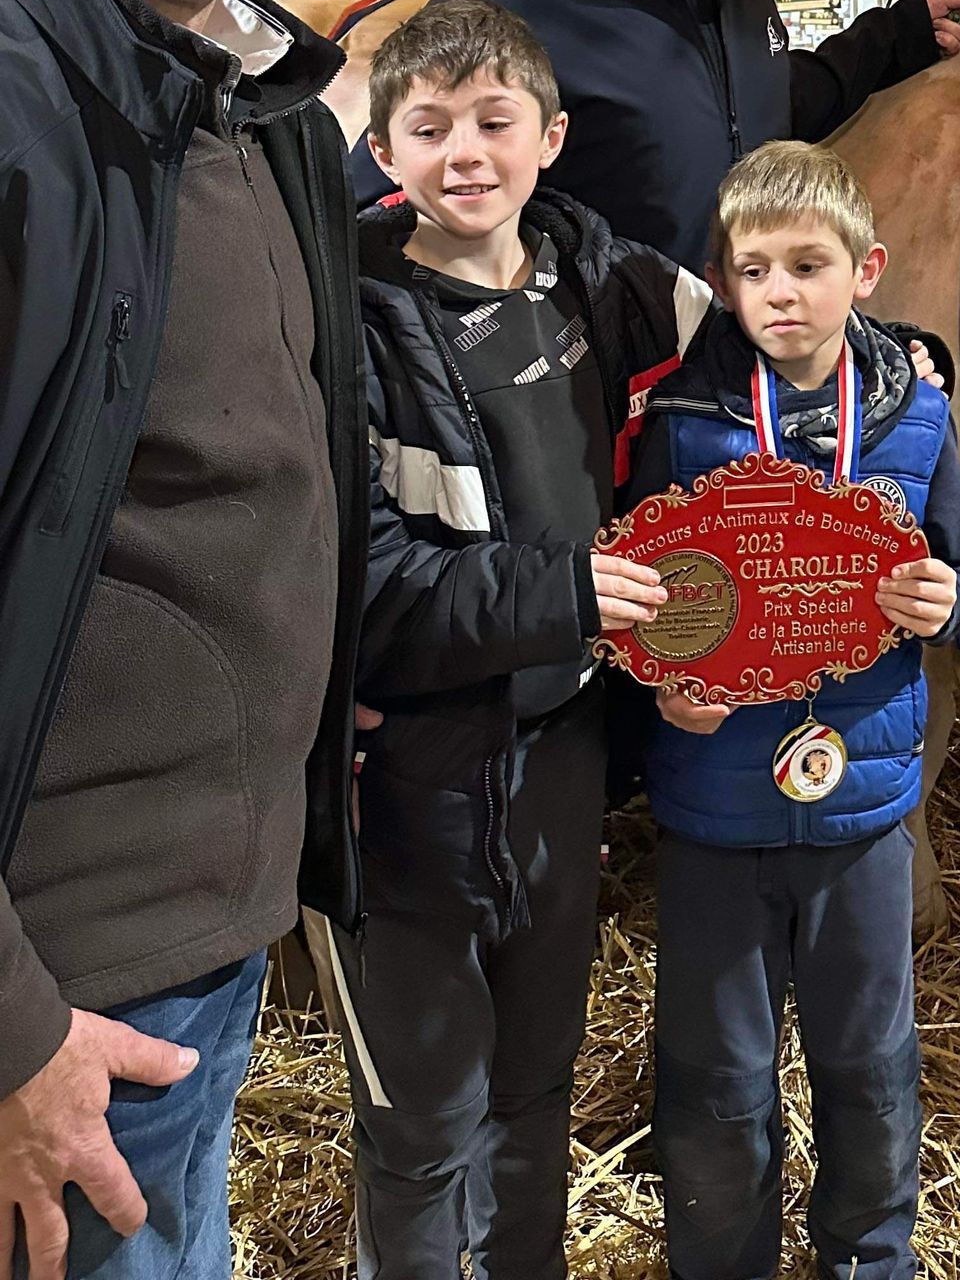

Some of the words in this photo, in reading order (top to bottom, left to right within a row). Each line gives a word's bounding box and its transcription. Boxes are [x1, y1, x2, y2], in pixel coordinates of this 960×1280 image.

[698, 512, 789, 534] d'Animaux
[794, 509, 815, 528] de
[820, 512, 900, 554] Boucherie
[735, 532, 785, 556] 2023
[739, 554, 879, 580] CHAROLLES
[668, 580, 726, 602] FBCT
[764, 600, 793, 617] Prix
[798, 596, 853, 616] Spécial
[749, 624, 768, 640] de
[771, 623, 785, 639] la
[789, 619, 867, 639] Boucherie
[770, 638, 846, 657] Artisanale
